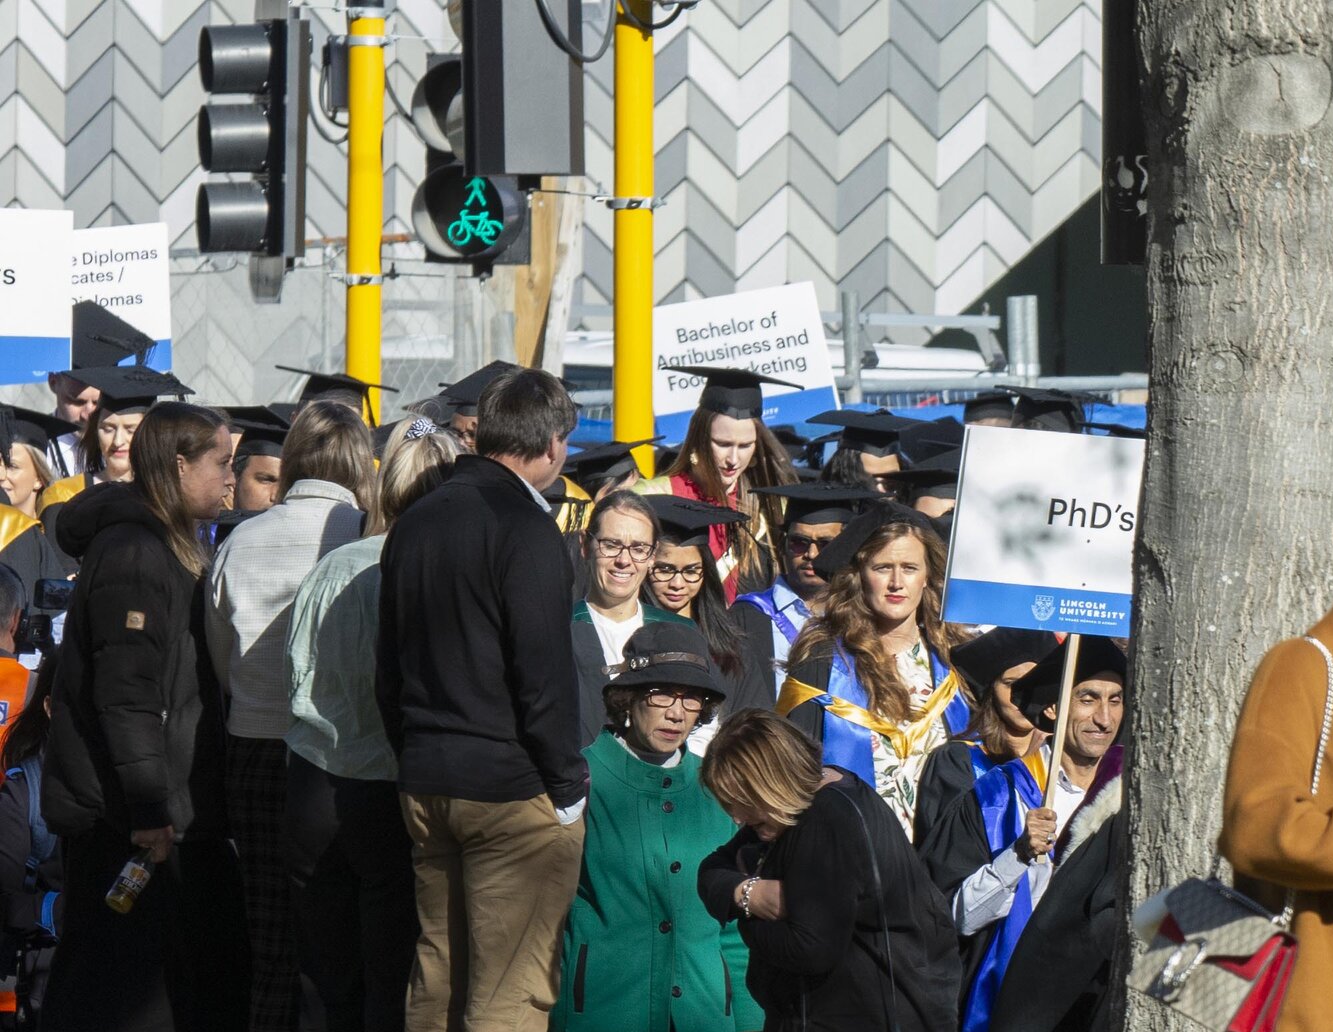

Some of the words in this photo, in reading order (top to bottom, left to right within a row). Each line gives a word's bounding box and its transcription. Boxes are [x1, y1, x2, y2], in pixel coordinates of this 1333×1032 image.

[82, 248, 158, 267] Diplomas
[676, 317, 755, 344] Bachelor
[760, 311, 778, 328] of
[657, 340, 771, 370] Agribusiness
[776, 329, 809, 349] and
[1060, 599, 1107, 610] LINCOLN
[1060, 607, 1126, 620] UNIVERSITY
